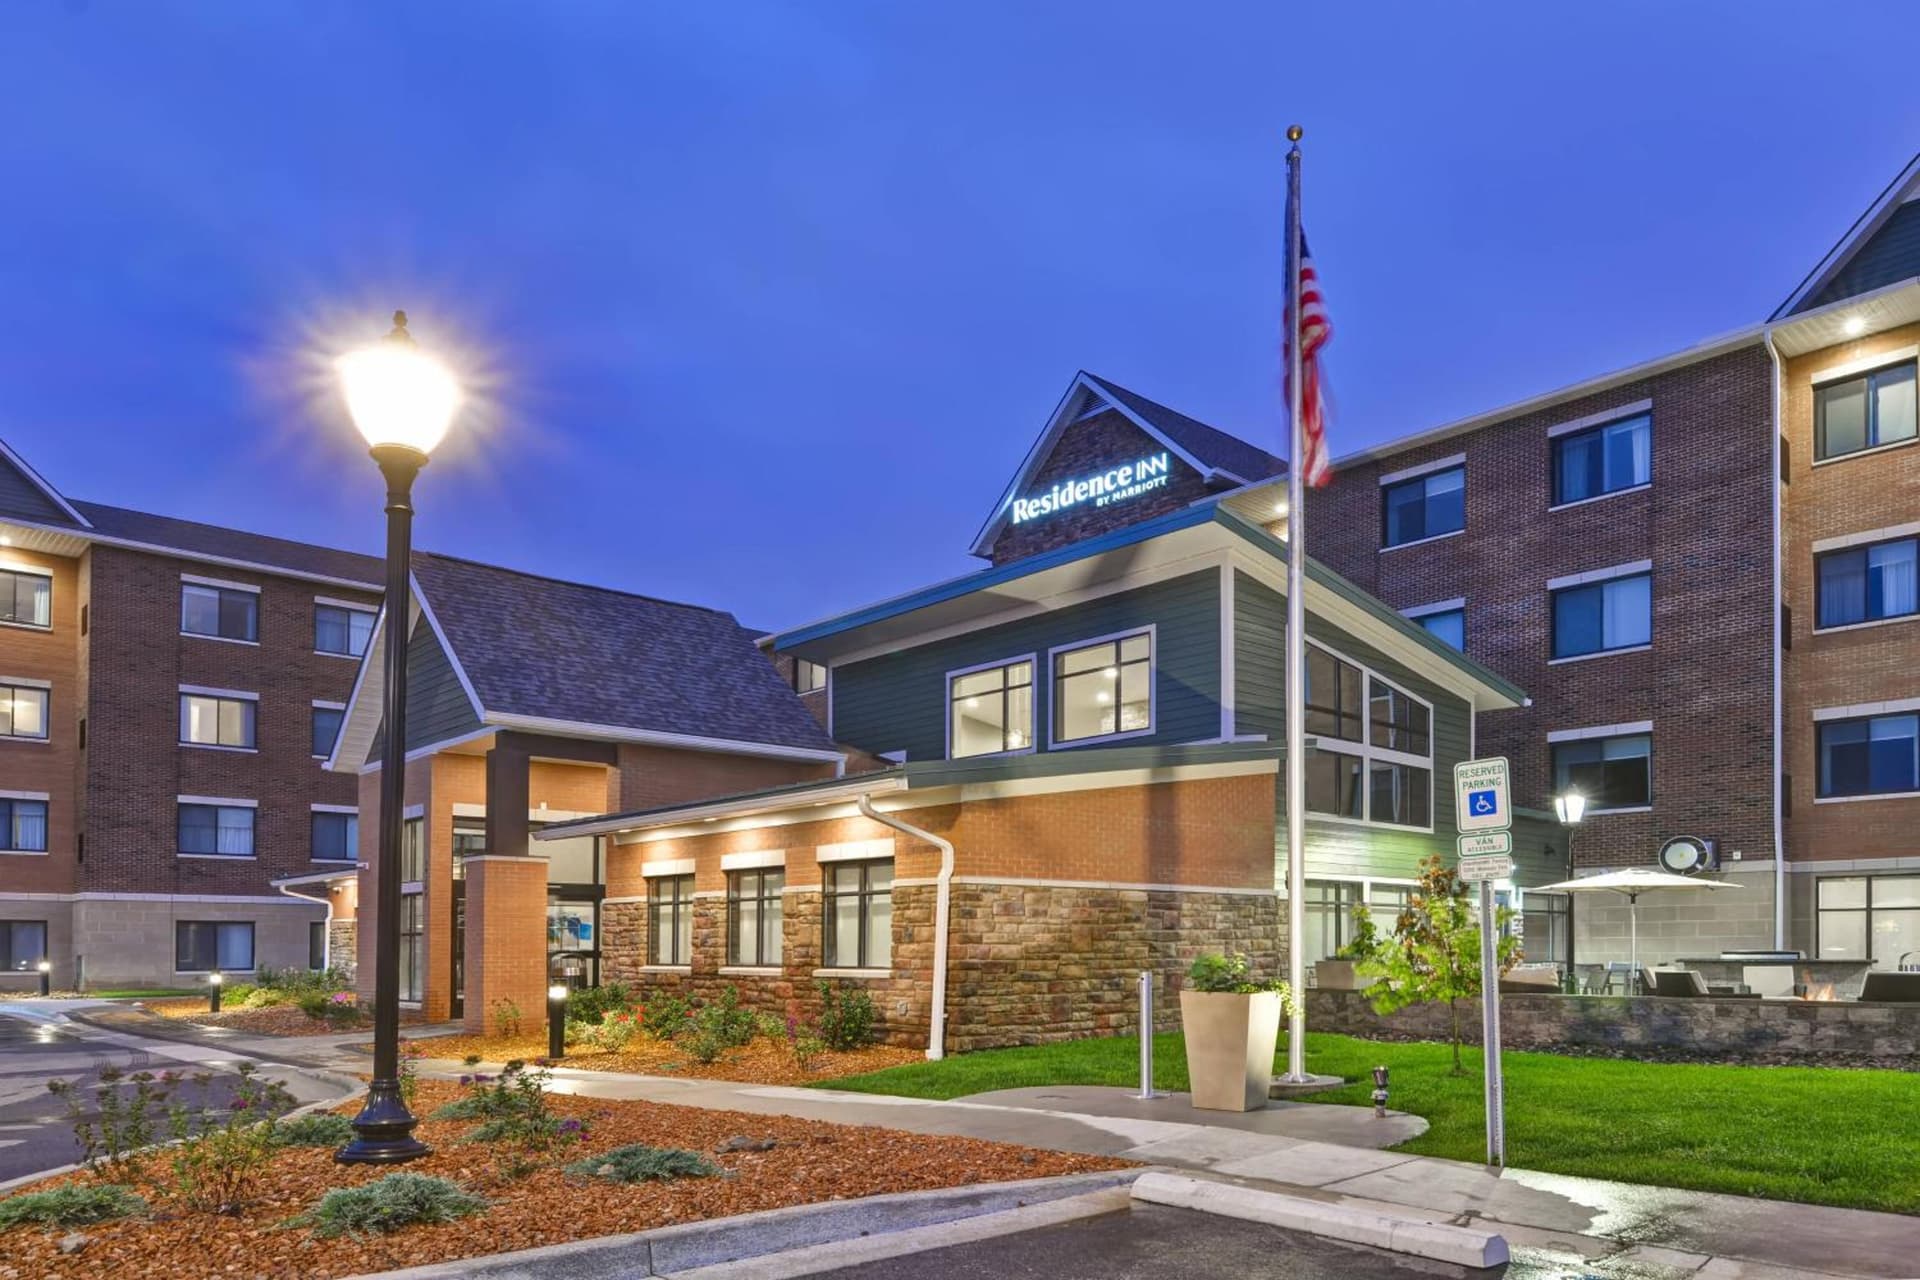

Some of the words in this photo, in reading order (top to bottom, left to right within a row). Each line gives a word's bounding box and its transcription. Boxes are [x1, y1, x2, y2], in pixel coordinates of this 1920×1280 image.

[1012, 465, 1133, 524] Residence
[1136, 452, 1168, 481] INN
[1096, 495, 1110, 507] BY
[1112, 475, 1168, 502] MARRIOTT
[1459, 765, 1504, 778] RESERVED
[1462, 777, 1502, 790] PARKING
[1475, 837, 1494, 846] VAN
